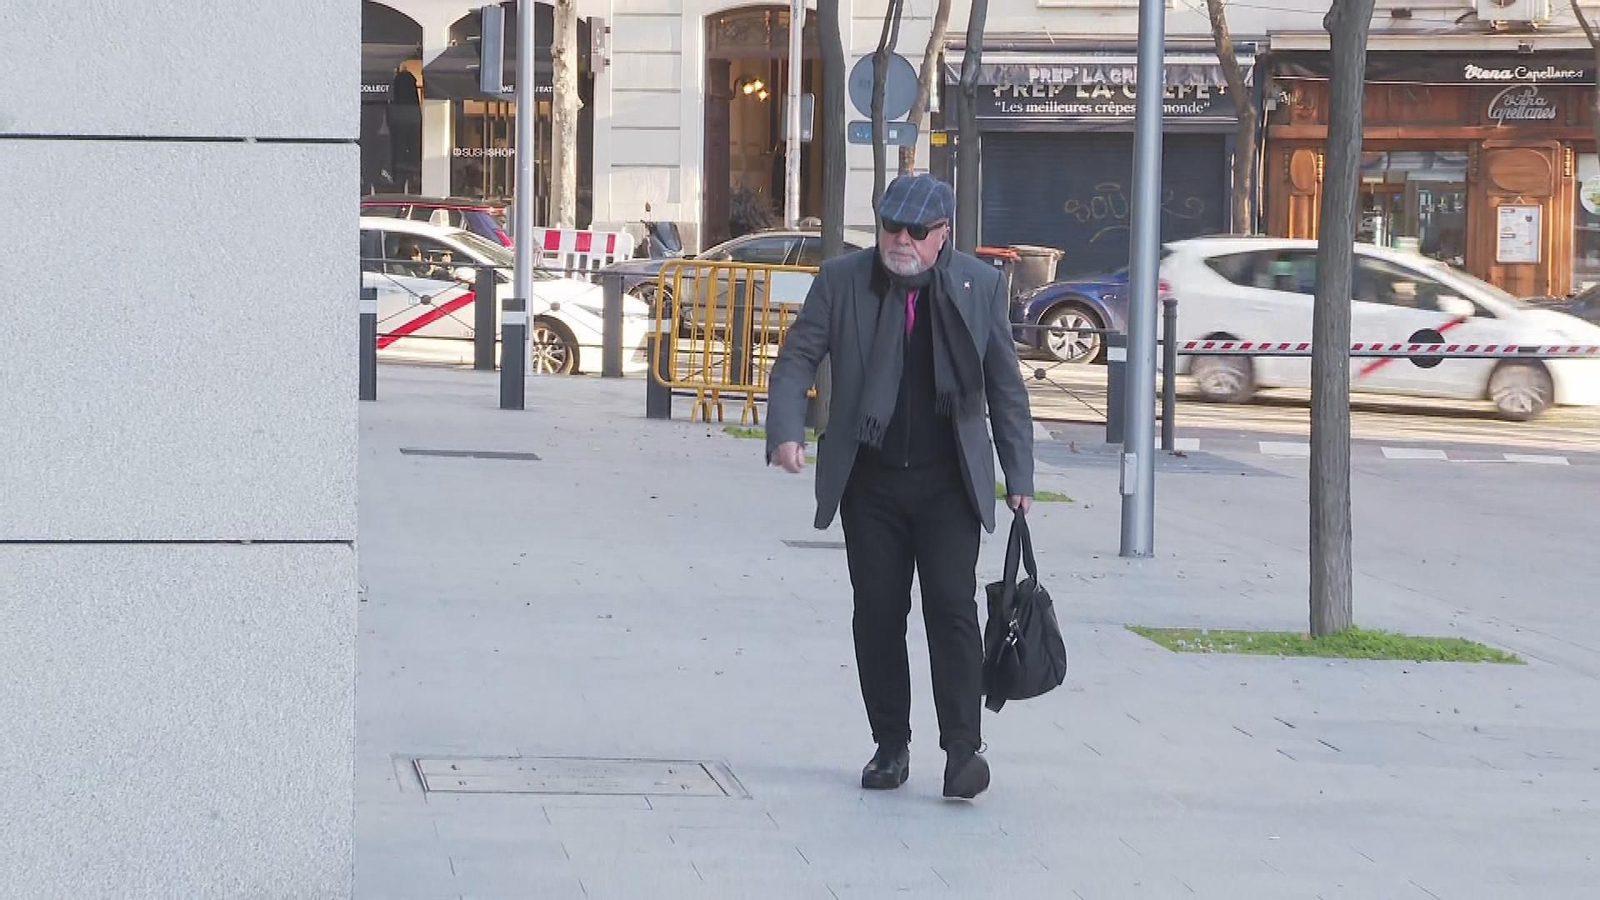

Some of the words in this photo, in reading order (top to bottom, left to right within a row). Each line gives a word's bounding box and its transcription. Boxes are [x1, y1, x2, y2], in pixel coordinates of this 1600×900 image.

[1082, 67, 1107, 83] LA
[1025, 101, 1092, 113] meilleures
[1094, 101, 1136, 116] crêpes
